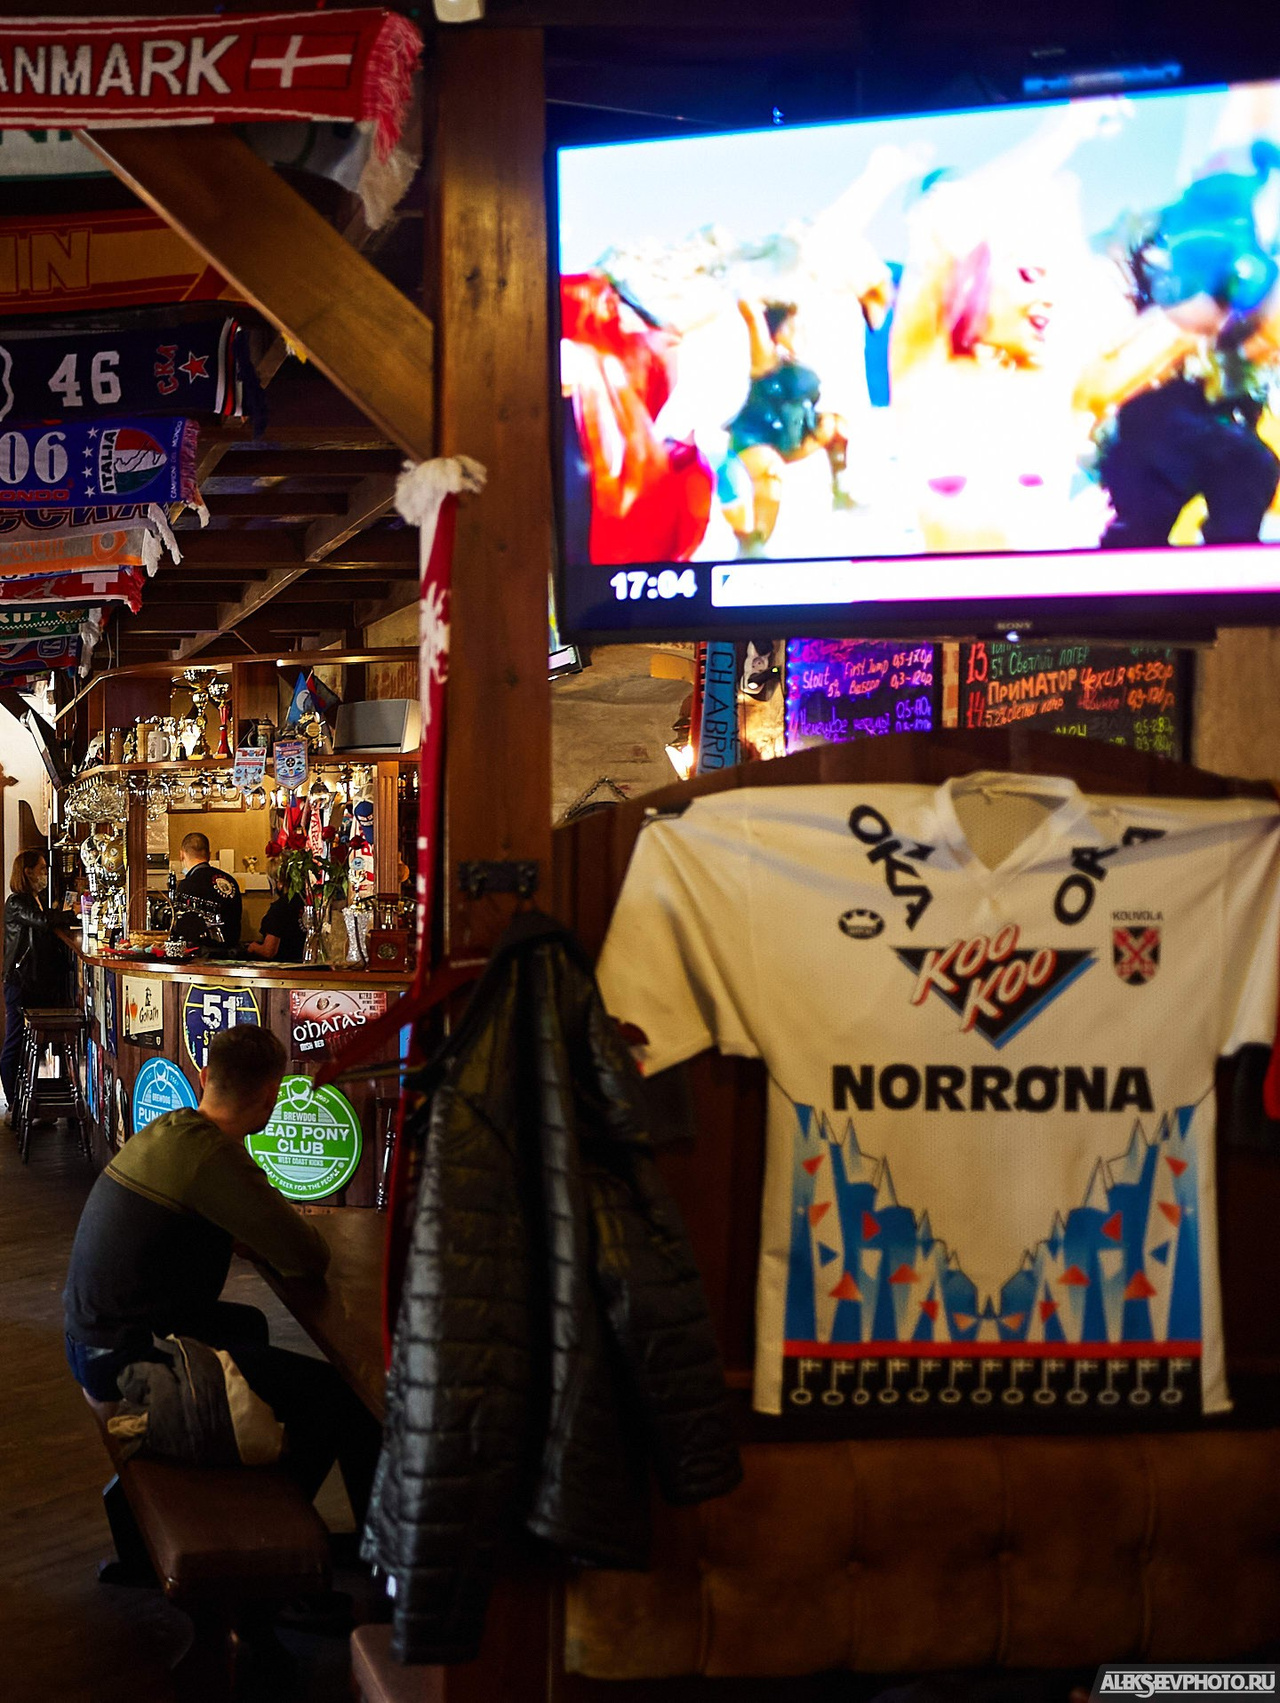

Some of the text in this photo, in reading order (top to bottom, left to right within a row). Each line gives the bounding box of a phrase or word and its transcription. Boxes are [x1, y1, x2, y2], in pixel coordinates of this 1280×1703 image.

[47, 349, 122, 408] 46
[100, 430, 118, 492] ITALIA
[609, 568, 699, 601] 17:04
[995, 620, 1033, 630] SONY
[1111, 910, 1164, 921] KOUVOLA
[911, 923, 1021, 1006] KOO
[959, 946, 1059, 1034] KOO
[201, 993, 238, 1030] 51
[831, 1062, 1157, 1115] NORRØNA
[258, 1123, 350, 1142] EAD PONY
[283, 1111, 317, 1123] BREWDOG
[277, 1138, 325, 1155] CLUB
[261, 1162, 279, 1183] CRAFT
[321, 1168, 341, 1188] PEOPLE
